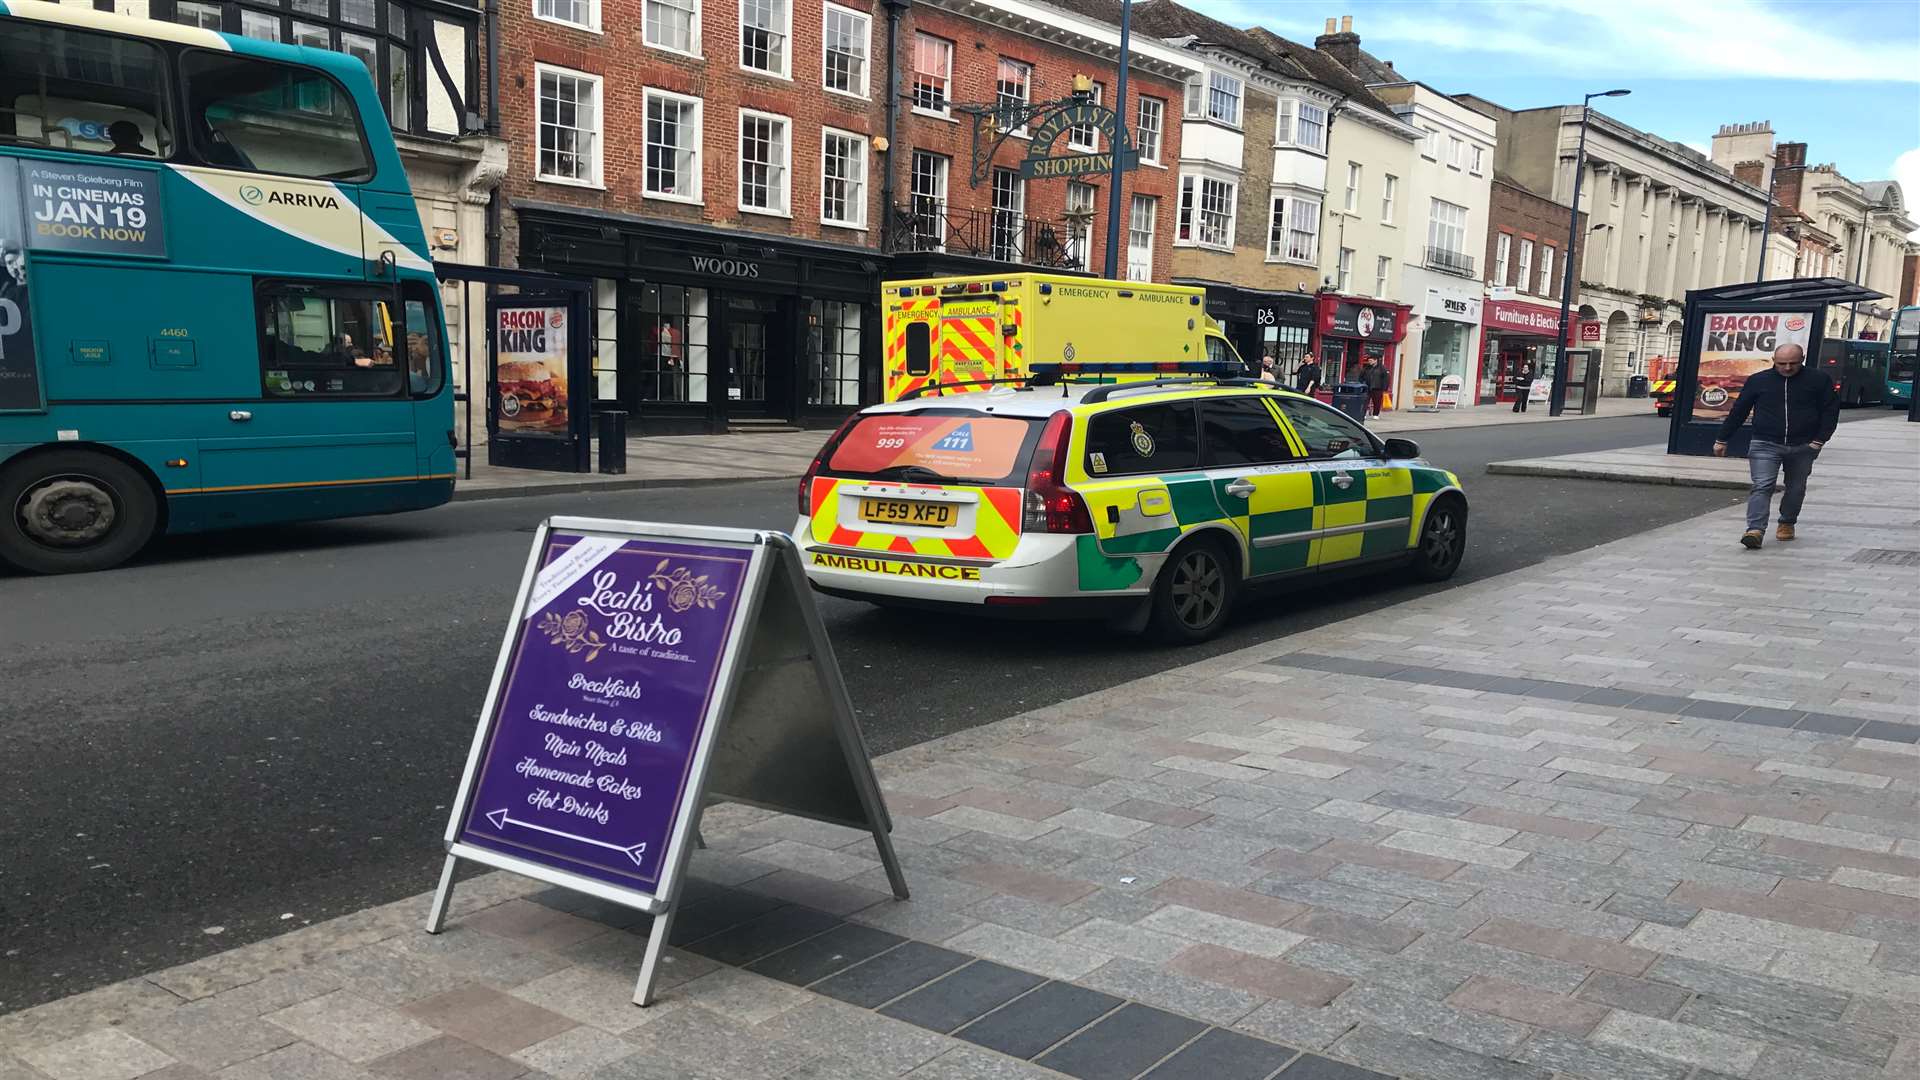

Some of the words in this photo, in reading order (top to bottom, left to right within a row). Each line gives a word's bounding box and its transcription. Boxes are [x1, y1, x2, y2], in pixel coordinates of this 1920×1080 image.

[1031, 106, 1086, 156] ROYAL
[1034, 154, 1112, 176] SHOPPIN
[31, 170, 39, 178] A
[42, 170, 75, 181] Steven
[77, 173, 122, 187] Spielberg
[124, 178, 143, 188] Film
[32, 184, 53, 198] IN
[57, 187, 145, 206] CINEMAS
[268, 191, 340, 210] ARRIVA
[34, 200, 105, 225] JAN
[110, 206, 147, 228] 19
[37, 224, 97, 239] BOOK
[100, 228, 146, 242] NOW
[692, 256, 759, 278] WOODS
[1059, 287, 1110, 299] EMERGENCY
[1139, 293, 1184, 304] AMBULANCE
[500, 311, 546, 328] BACON
[898, 310, 938, 320] EMERGENCY
[948, 306, 991, 315] AMBULANCE
[1496, 306, 1529, 325] Furniture
[1530, 313, 1536, 326] &
[1710, 316, 1779, 331] BACON
[160, 328, 188, 337] 4460
[500, 330, 546, 352] KING
[1707, 332, 1776, 352] KING
[876, 438, 905, 448] 999
[943, 437, 969, 448] 111
[864, 501, 908, 520] LF59
[914, 504, 949, 522] XFD
[813, 553, 980, 581] AMBULANCE
[577, 569, 652, 617] Leah's
[606, 612, 682, 646] Bistro
[608, 642, 616, 652] A
[618, 646, 638, 654] taste
[639, 647, 652, 656] of
[568, 672, 642, 699] Breakfasts
[529, 704, 607, 733] Sandwiches
[610, 718, 625, 736] &
[626, 721, 662, 743] Bites
[544, 732, 582, 758] Main
[585, 741, 628, 766] Meals
[516, 756, 594, 789] Homemade
[597, 775, 642, 800] Cakes
[528, 788, 560, 811] Hot
[558, 796, 609, 824] Drinks
